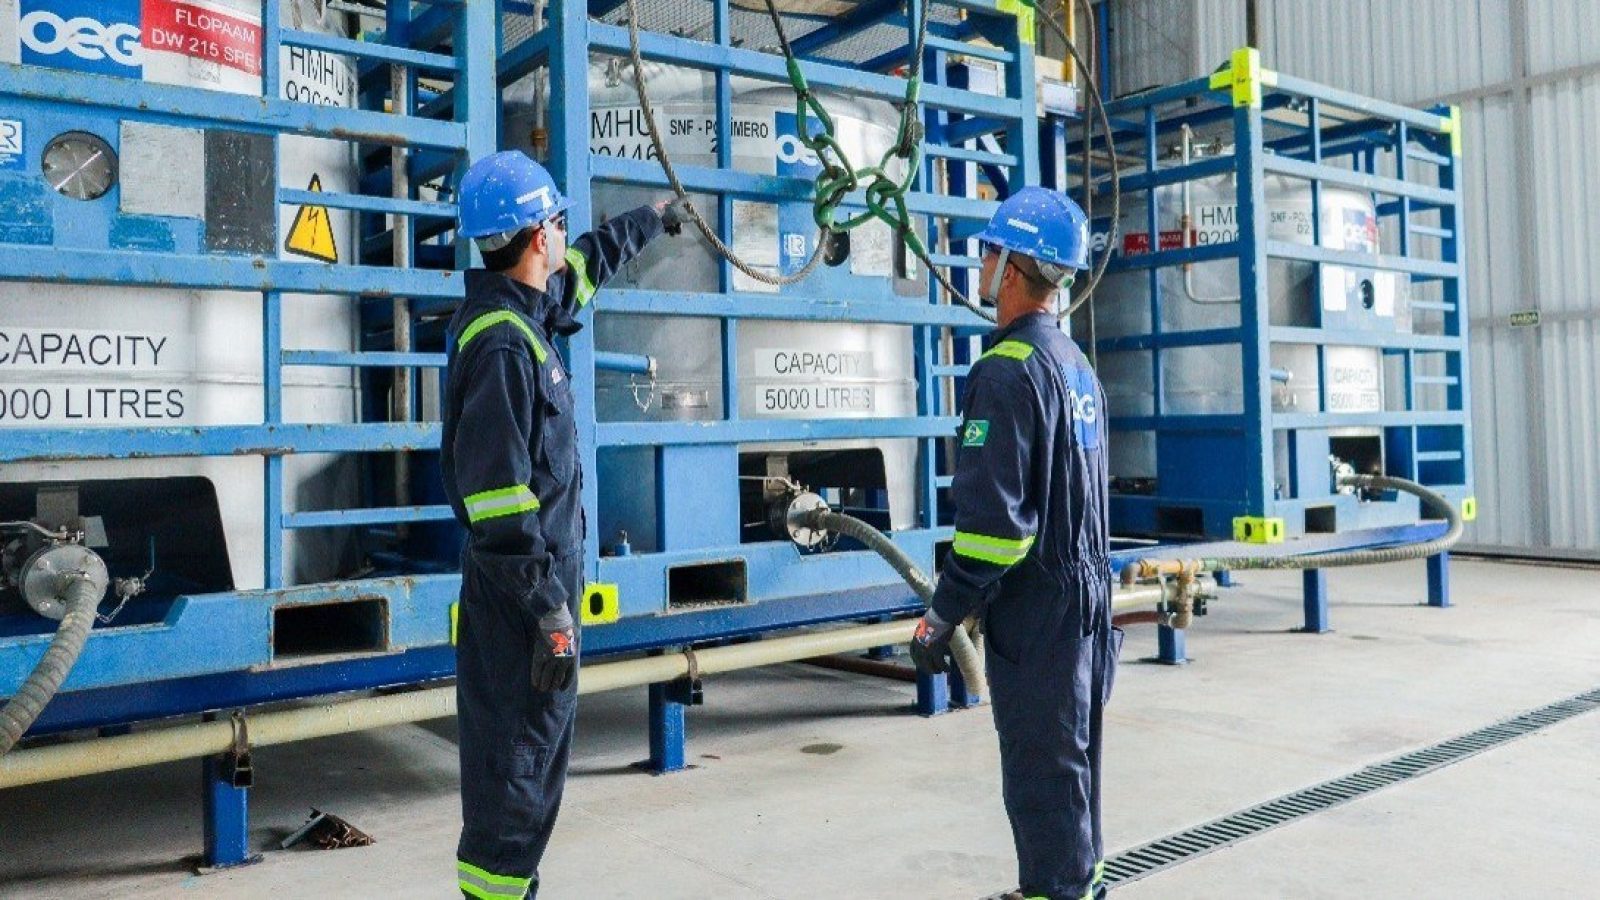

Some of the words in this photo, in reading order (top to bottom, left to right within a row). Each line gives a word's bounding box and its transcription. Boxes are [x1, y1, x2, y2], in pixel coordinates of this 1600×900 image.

[175, 8, 255, 44] FLOPAAM
[151, 28, 185, 49] DW
[188, 37, 220, 57] 215
[224, 46, 262, 69] SPE
[670, 118, 694, 136] SNF
[774, 351, 860, 375] CAPACITY
[65, 388, 184, 418] LITRES
[765, 388, 810, 410] 5000
[815, 387, 870, 409] LITRES
